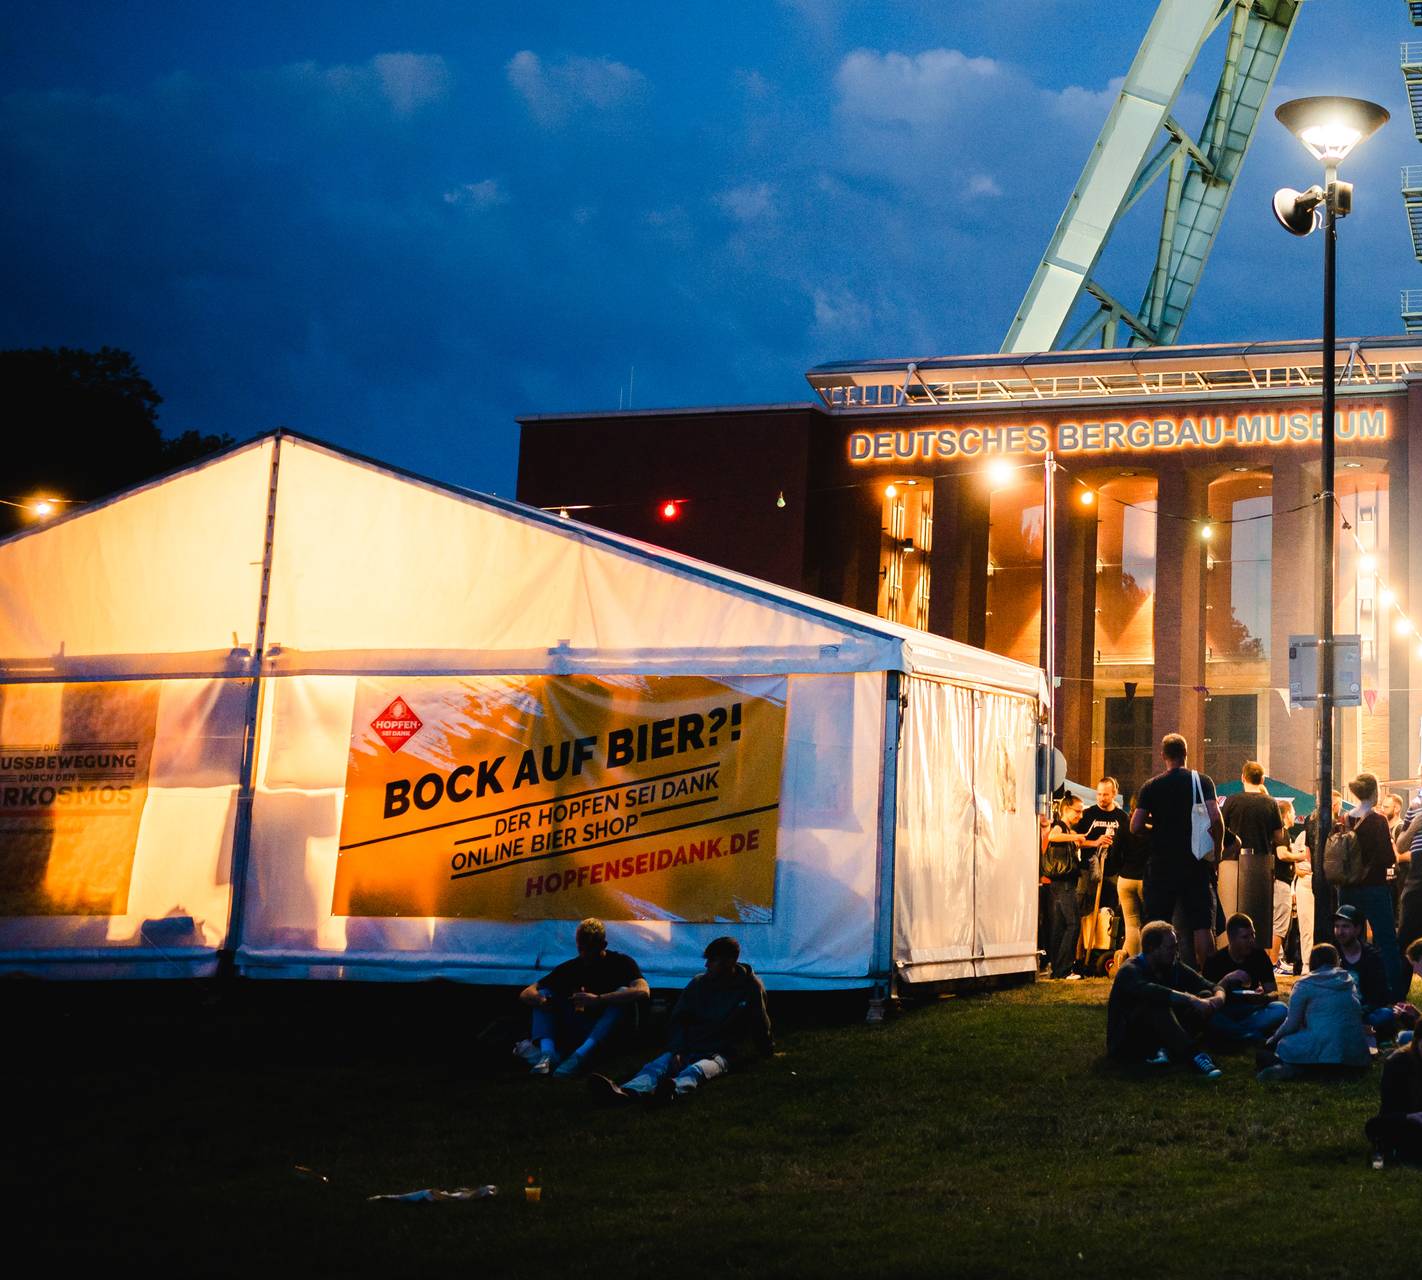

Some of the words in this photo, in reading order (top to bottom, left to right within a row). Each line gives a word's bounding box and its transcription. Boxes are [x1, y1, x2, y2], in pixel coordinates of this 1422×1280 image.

[850, 426, 1048, 460] DEUTSCHES
[1057, 410, 1386, 451] BERGBAU-MUSEUM
[376, 720, 418, 729] HOPFEN
[383, 755, 507, 819] BOCK
[512, 735, 597, 790] AUF
[606, 702, 742, 769] BIER?!
[494, 811, 531, 837] DER
[538, 792, 620, 827] HOPFEN
[625, 785, 656, 808] SEI
[661, 769, 720, 801] DANK
[451, 836, 525, 871] ONLINE
[530, 826, 576, 854] BIER
[582, 813, 639, 843] SHOP
[525, 828, 760, 899] HOPFENSEIDANK.DE
